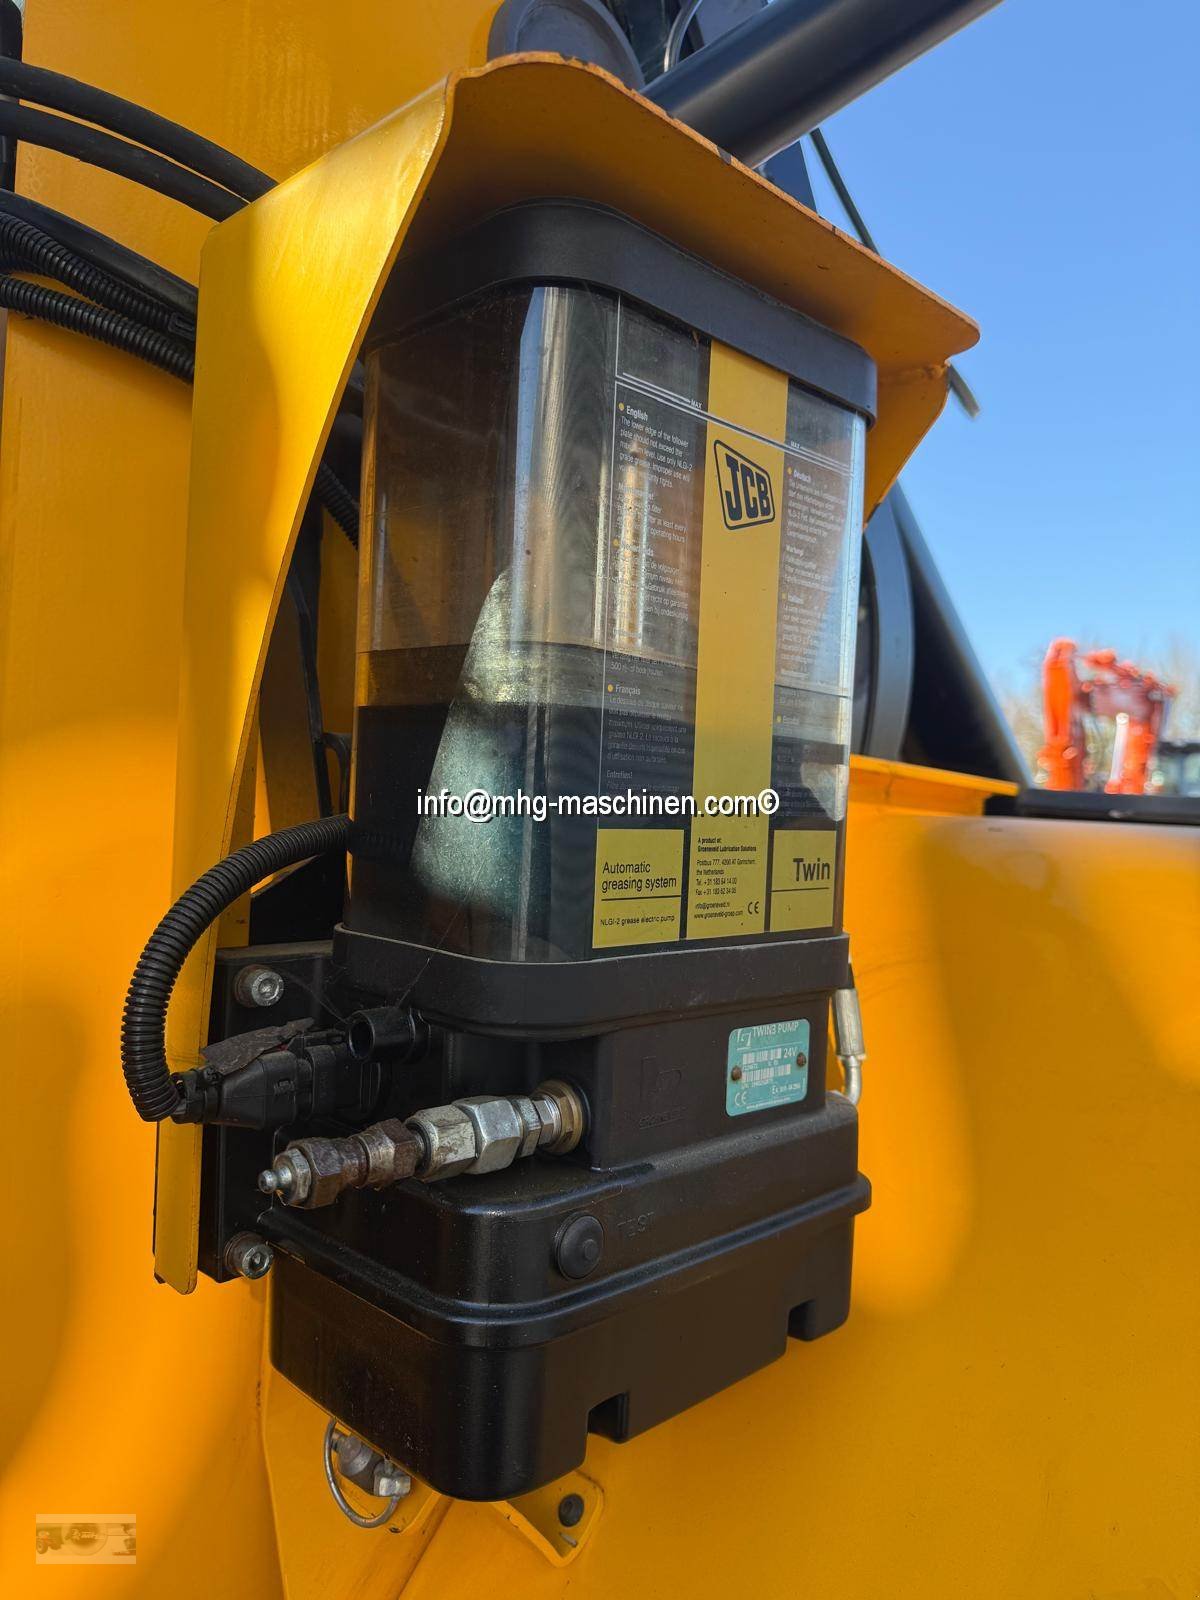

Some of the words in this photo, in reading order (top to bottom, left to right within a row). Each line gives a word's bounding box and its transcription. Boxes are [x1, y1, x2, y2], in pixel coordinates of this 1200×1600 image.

[690, 400, 702, 410] MAX
[626, 405, 648, 420] English
[622, 416, 630, 426] The
[725, 453, 772, 521] JCB
[615, 684, 640, 696] Français
[602, 860, 650, 874] Automatic
[793, 858, 830, 882] Twin
[601, 877, 642, 894] greasing
[645, 877, 676, 892] system
[621, 917, 640, 926] grease
[640, 915, 660, 924] electric
[660, 914, 674, 924] pump
[752, 1024, 776, 1038] TWIN3
[778, 1021, 799, 1033] PUMP
[784, 1046, 798, 1058] 24V
